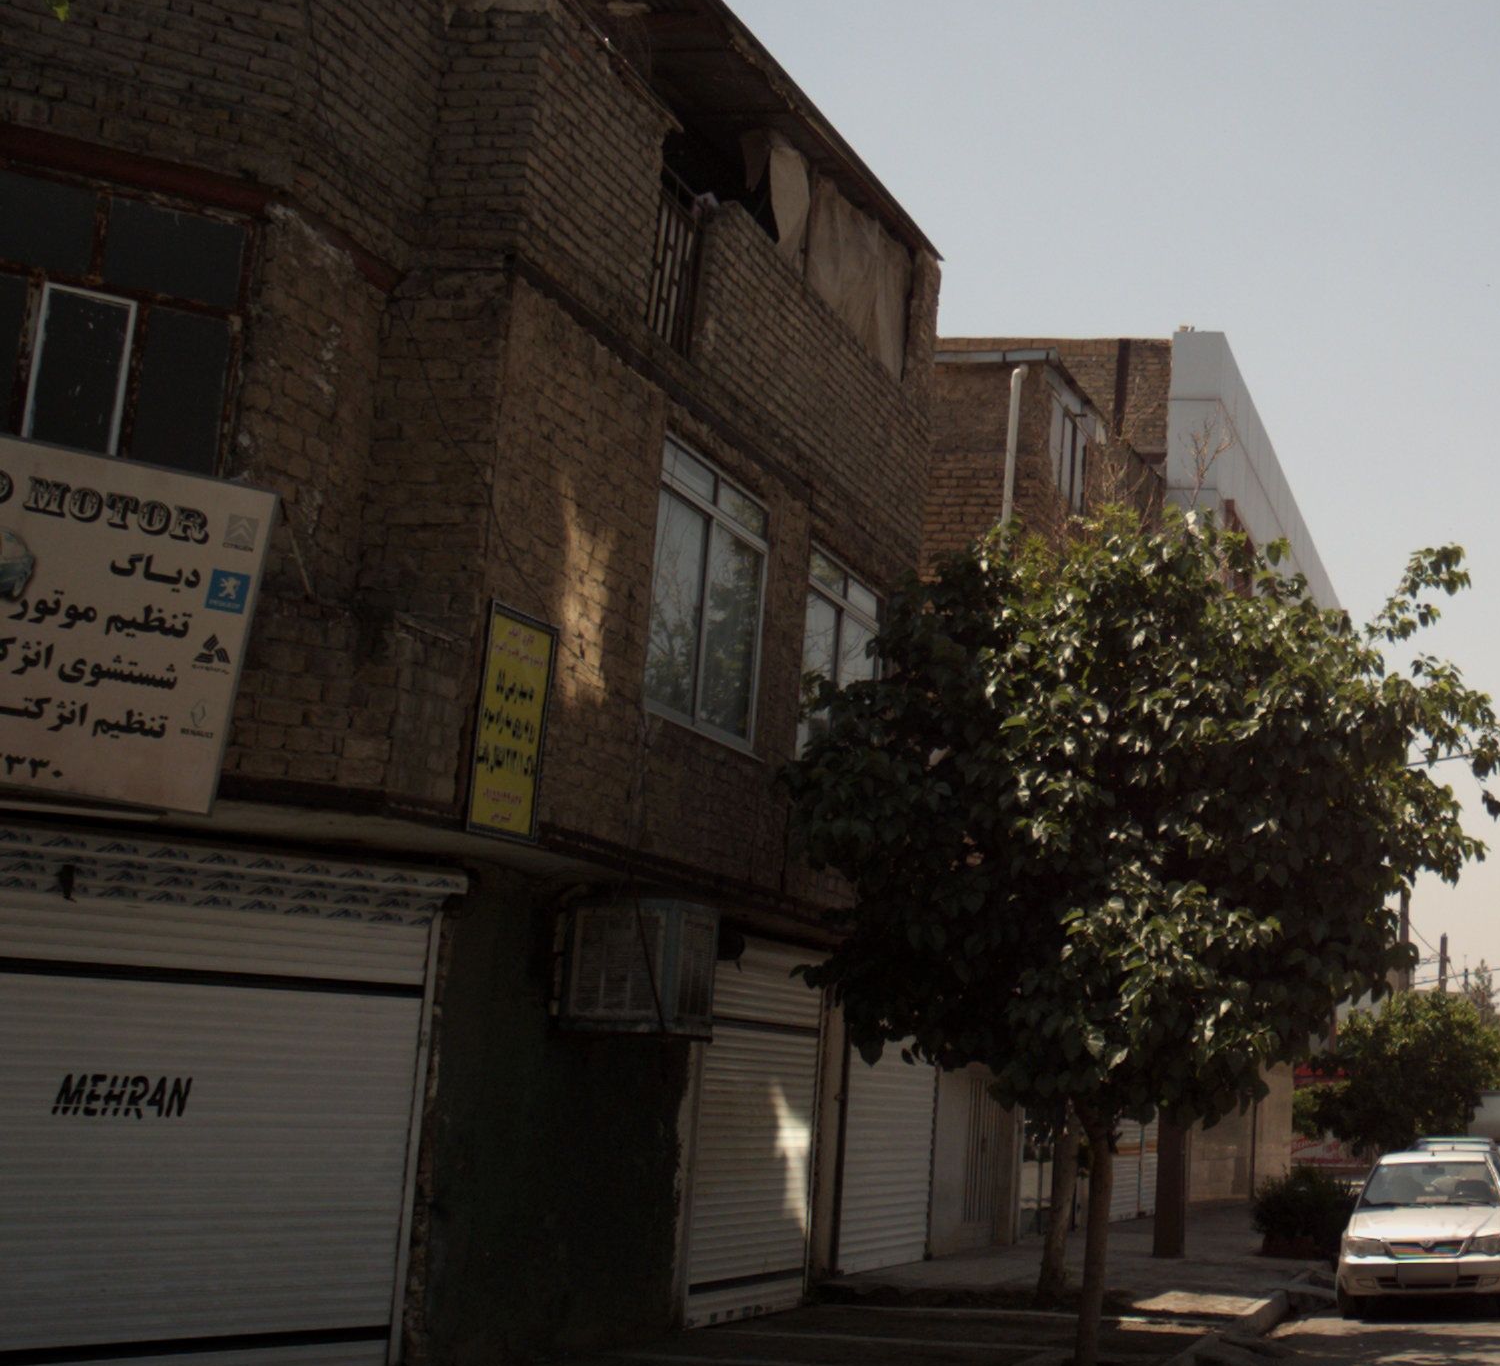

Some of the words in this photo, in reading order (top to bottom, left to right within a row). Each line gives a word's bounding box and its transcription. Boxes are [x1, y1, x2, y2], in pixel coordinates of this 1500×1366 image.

[23, 476, 209, 544] MOTOR
[8, 590, 97, 629] موتور
[105, 604, 192, 638] تنظیم
[58, 655, 177, 690] شستشوی
[92, 709, 168, 739] تنظیم
[0, 753, 63, 778] ۳۳۰
[51, 1073, 193, 1120] MEHRAN
